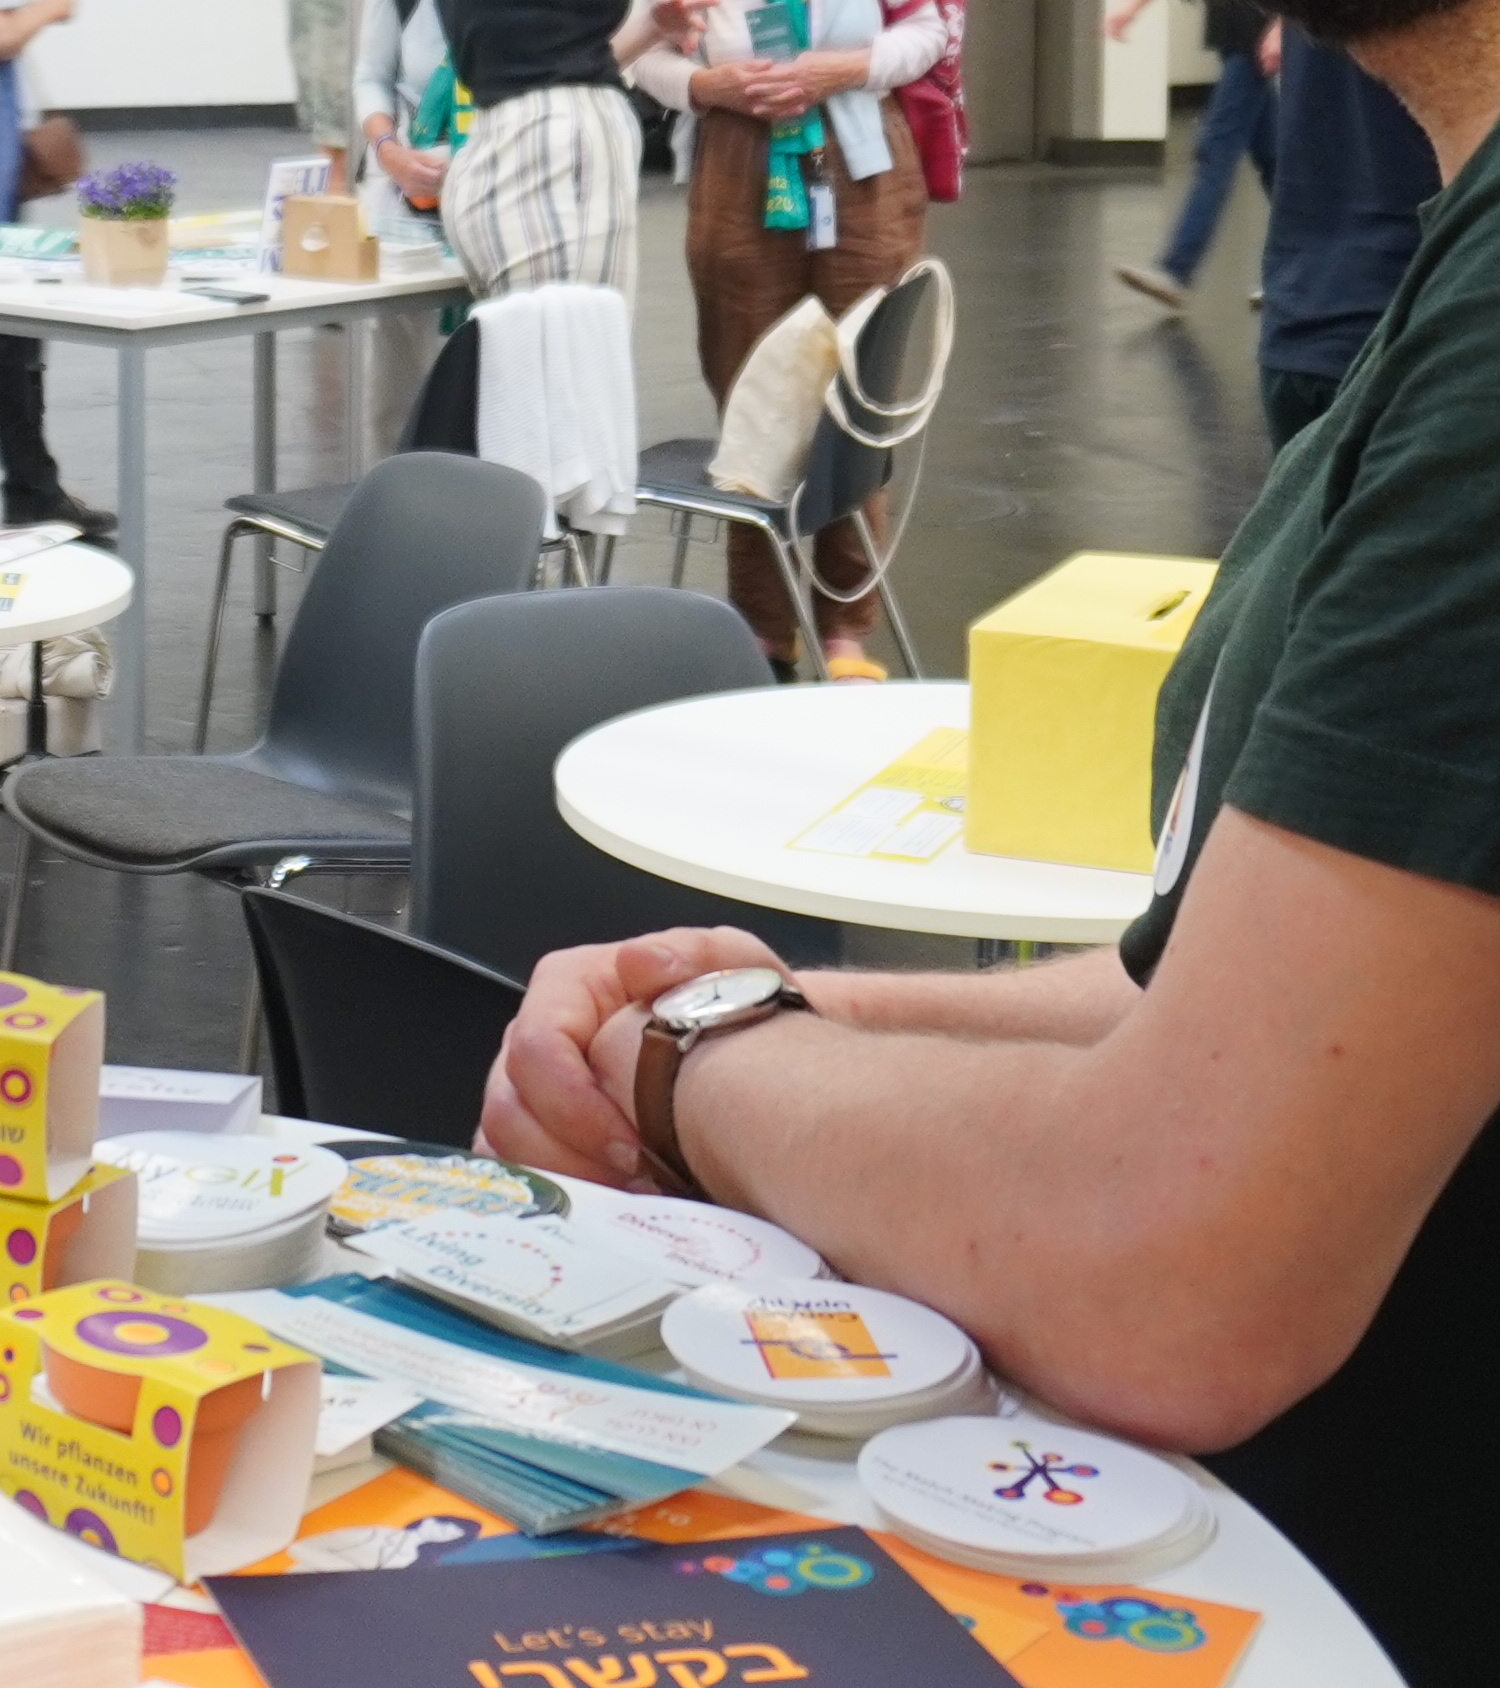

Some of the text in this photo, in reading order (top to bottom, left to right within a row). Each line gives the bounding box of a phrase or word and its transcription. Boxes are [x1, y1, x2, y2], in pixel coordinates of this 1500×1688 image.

[19, 1419, 51, 1448] Wir
[57, 1439, 140, 1487] pflanzen
[8, 1449, 156, 1526] unsere Zukunft!
[493, 1617, 715, 1655] Let's stay
